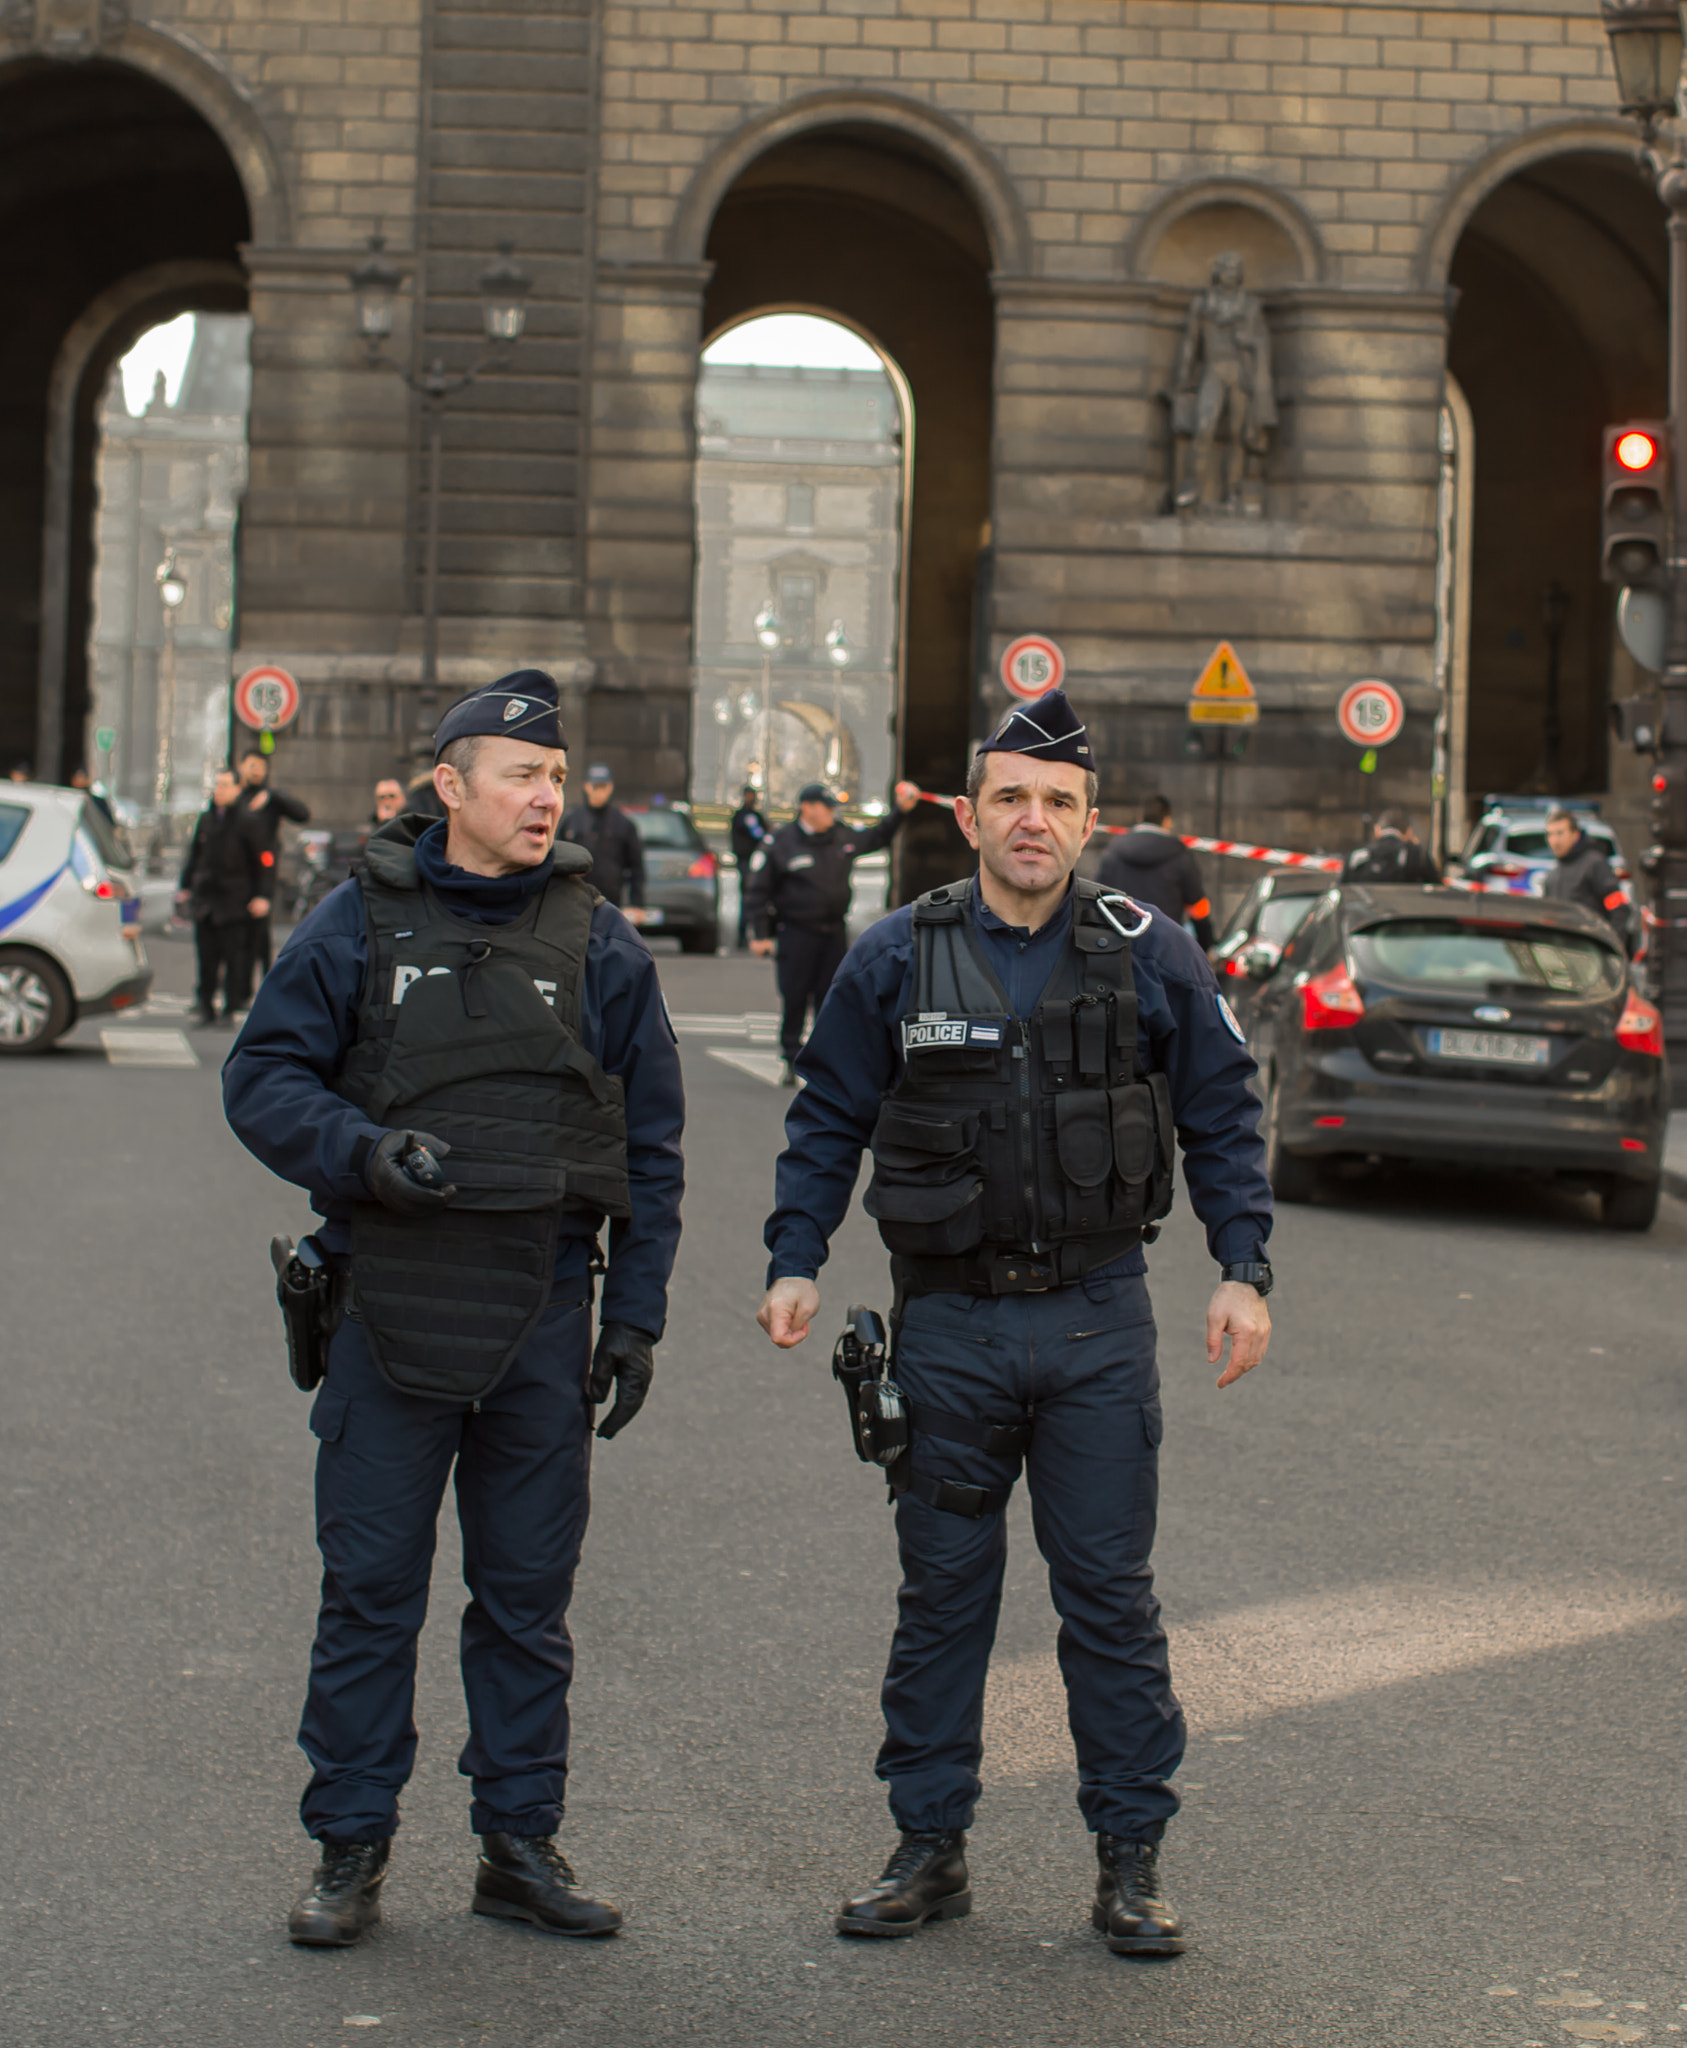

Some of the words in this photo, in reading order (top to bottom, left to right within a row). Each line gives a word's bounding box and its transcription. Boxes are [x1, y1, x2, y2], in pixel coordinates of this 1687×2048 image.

[1018, 654, 1048, 682] 15
[252, 684, 281, 711] 15
[1356, 699, 1386, 726] 15
[910, 1025, 963, 1044] POLICE
